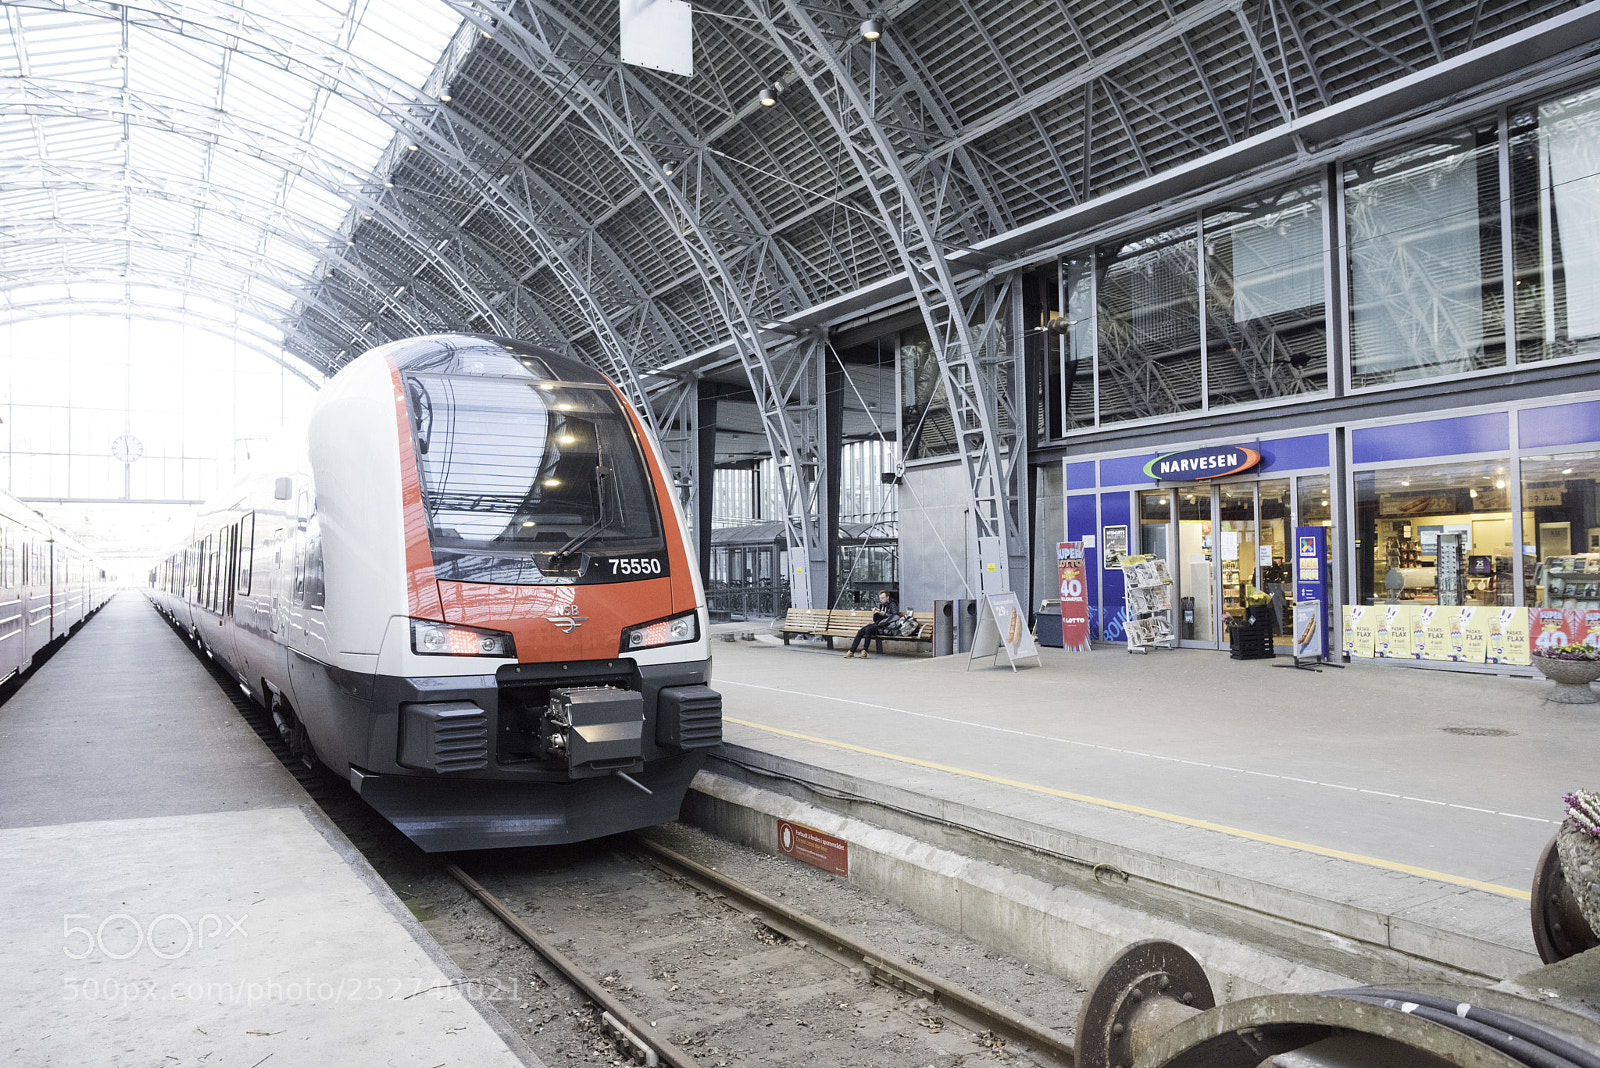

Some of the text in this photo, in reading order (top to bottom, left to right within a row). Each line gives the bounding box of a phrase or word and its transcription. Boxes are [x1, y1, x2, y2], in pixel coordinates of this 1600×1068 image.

[1160, 453, 1238, 474] NARVESEN
[1057, 548, 1083, 560] UPER
[608, 558, 661, 575] 75550
[1058, 559, 1083, 568] LOTTO
[1060, 579, 1083, 597] 40
[555, 604, 580, 616] NSB
[1535, 630, 1568, 649] 40
